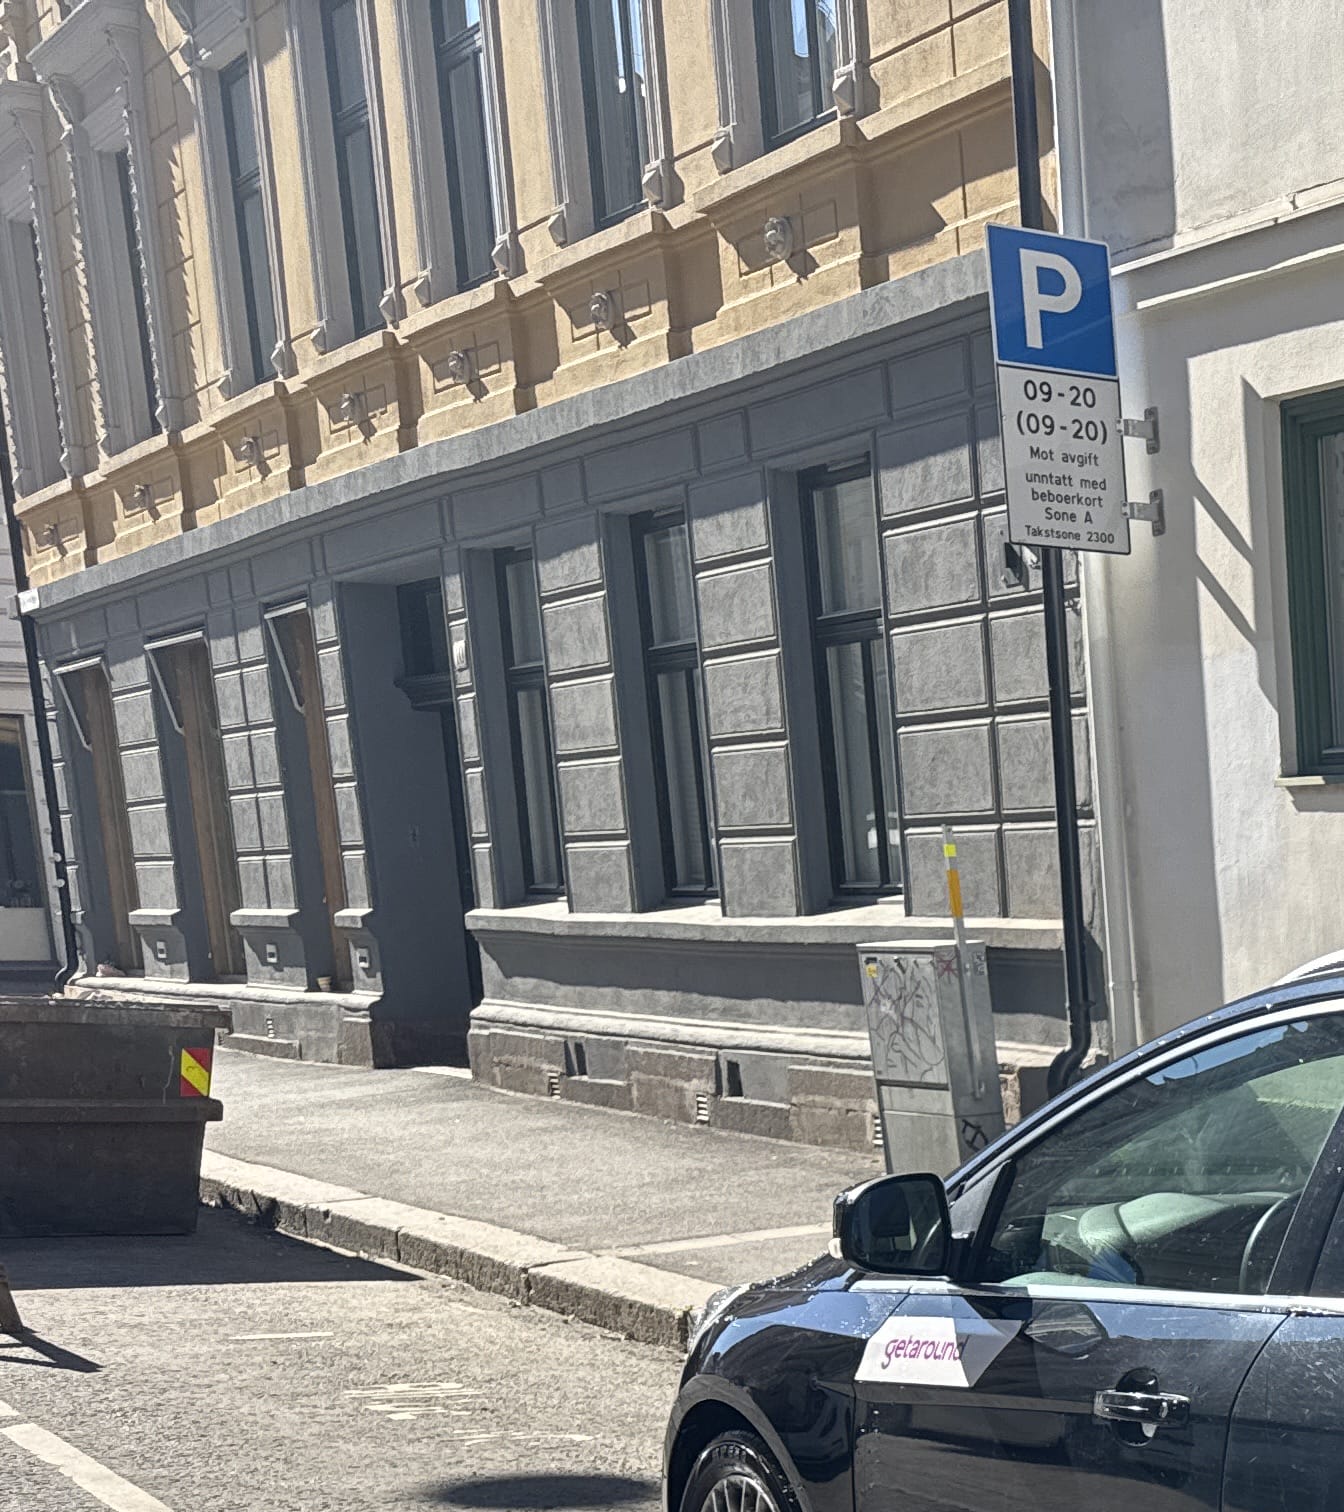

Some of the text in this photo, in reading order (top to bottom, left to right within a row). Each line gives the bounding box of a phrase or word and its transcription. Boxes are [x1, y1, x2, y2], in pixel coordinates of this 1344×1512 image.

[1019, 248, 1083, 350] P
[1029, 445, 1100, 468] Mot avgift
[1025, 472, 1107, 491] unntatt med
[1031, 487, 1104, 508] beboerkort
[1044, 506, 1093, 524] Sone A
[1024, 524, 1115, 544] Takstsone 2300
[881, 1335, 971, 1369] getaround
